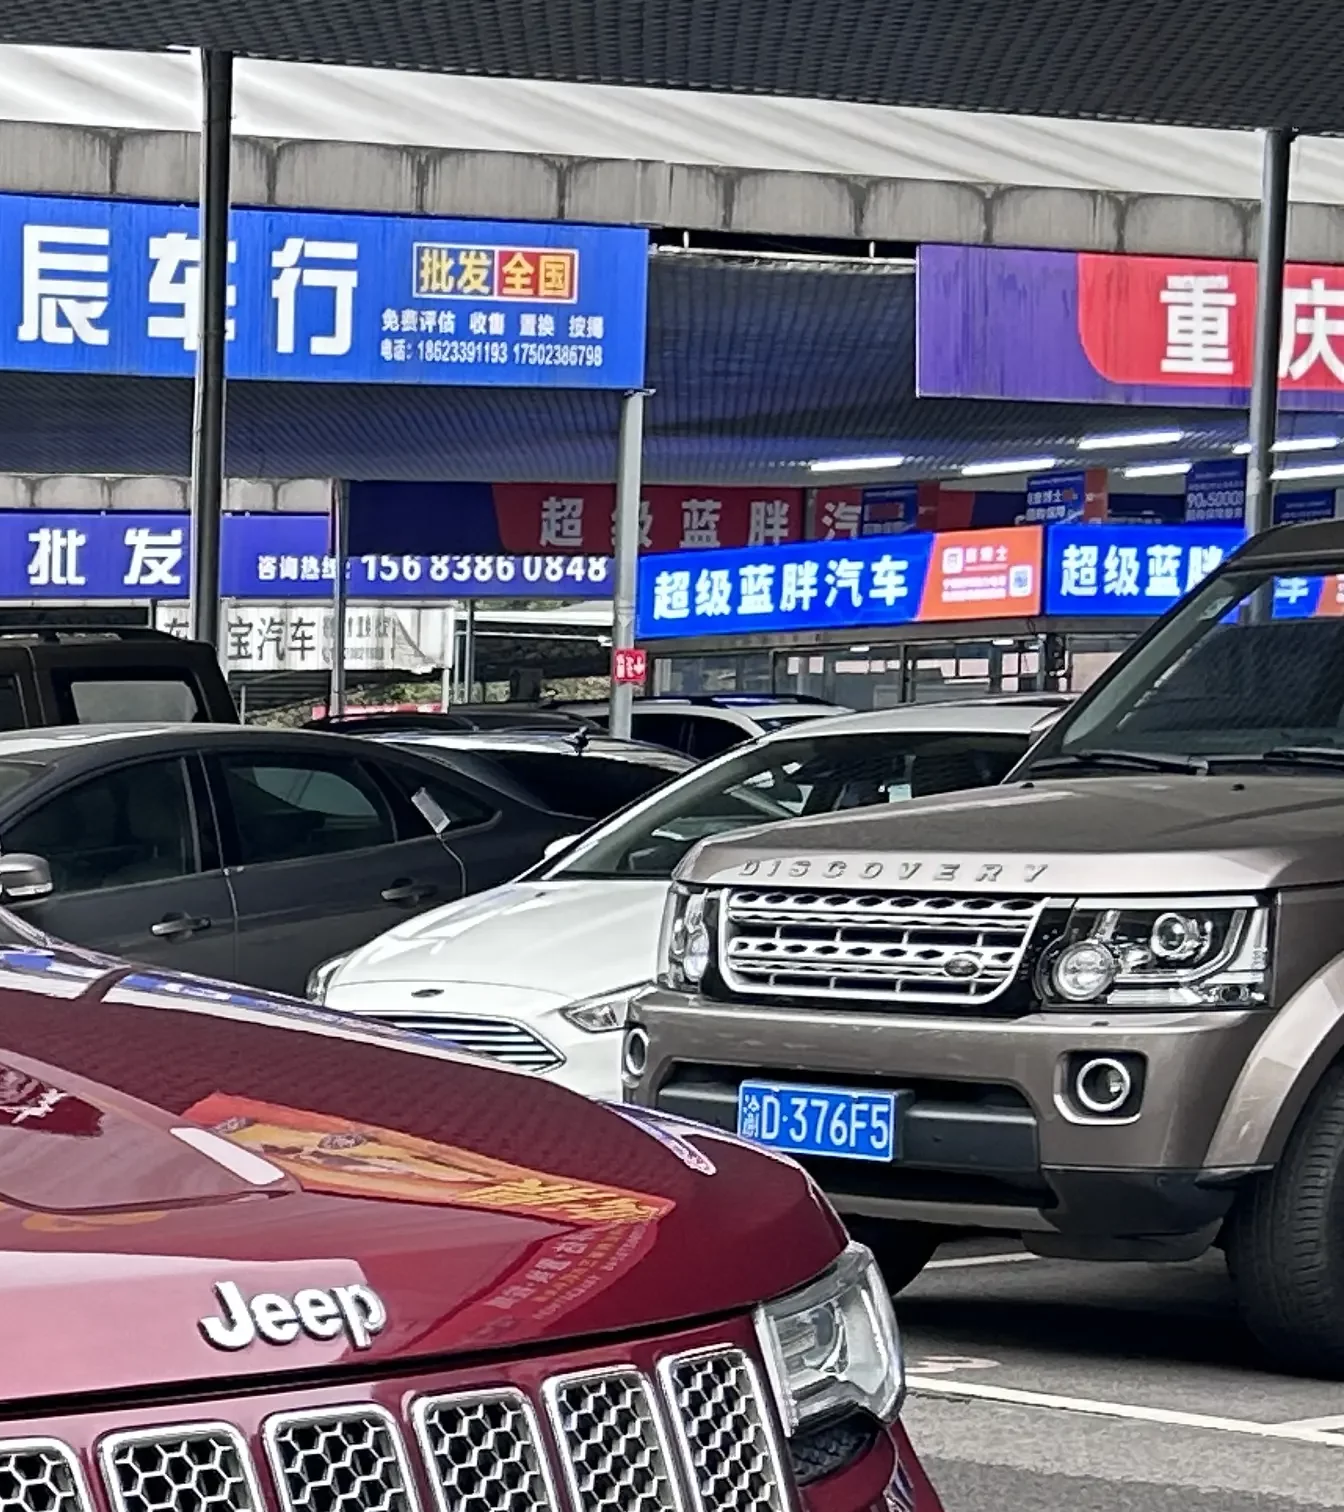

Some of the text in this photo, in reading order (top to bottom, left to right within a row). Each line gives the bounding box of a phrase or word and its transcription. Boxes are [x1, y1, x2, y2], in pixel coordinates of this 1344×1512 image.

[419, 248, 571, 299] 批发 全国
[381, 308, 456, 335] 免费评估
[1160, 274, 1344, 384] 重庆
[417, 340, 508, 365] 18623391193
[361, 555, 422, 582] 156
[429, 555, 513, 582] 8386
[523, 555, 608, 582] 0848
[654, 554, 909, 620] 超级蓝胖汽车
[738, 859, 1049, 884] DISCOVERY
[198, 1280, 388, 1351] Jeep
